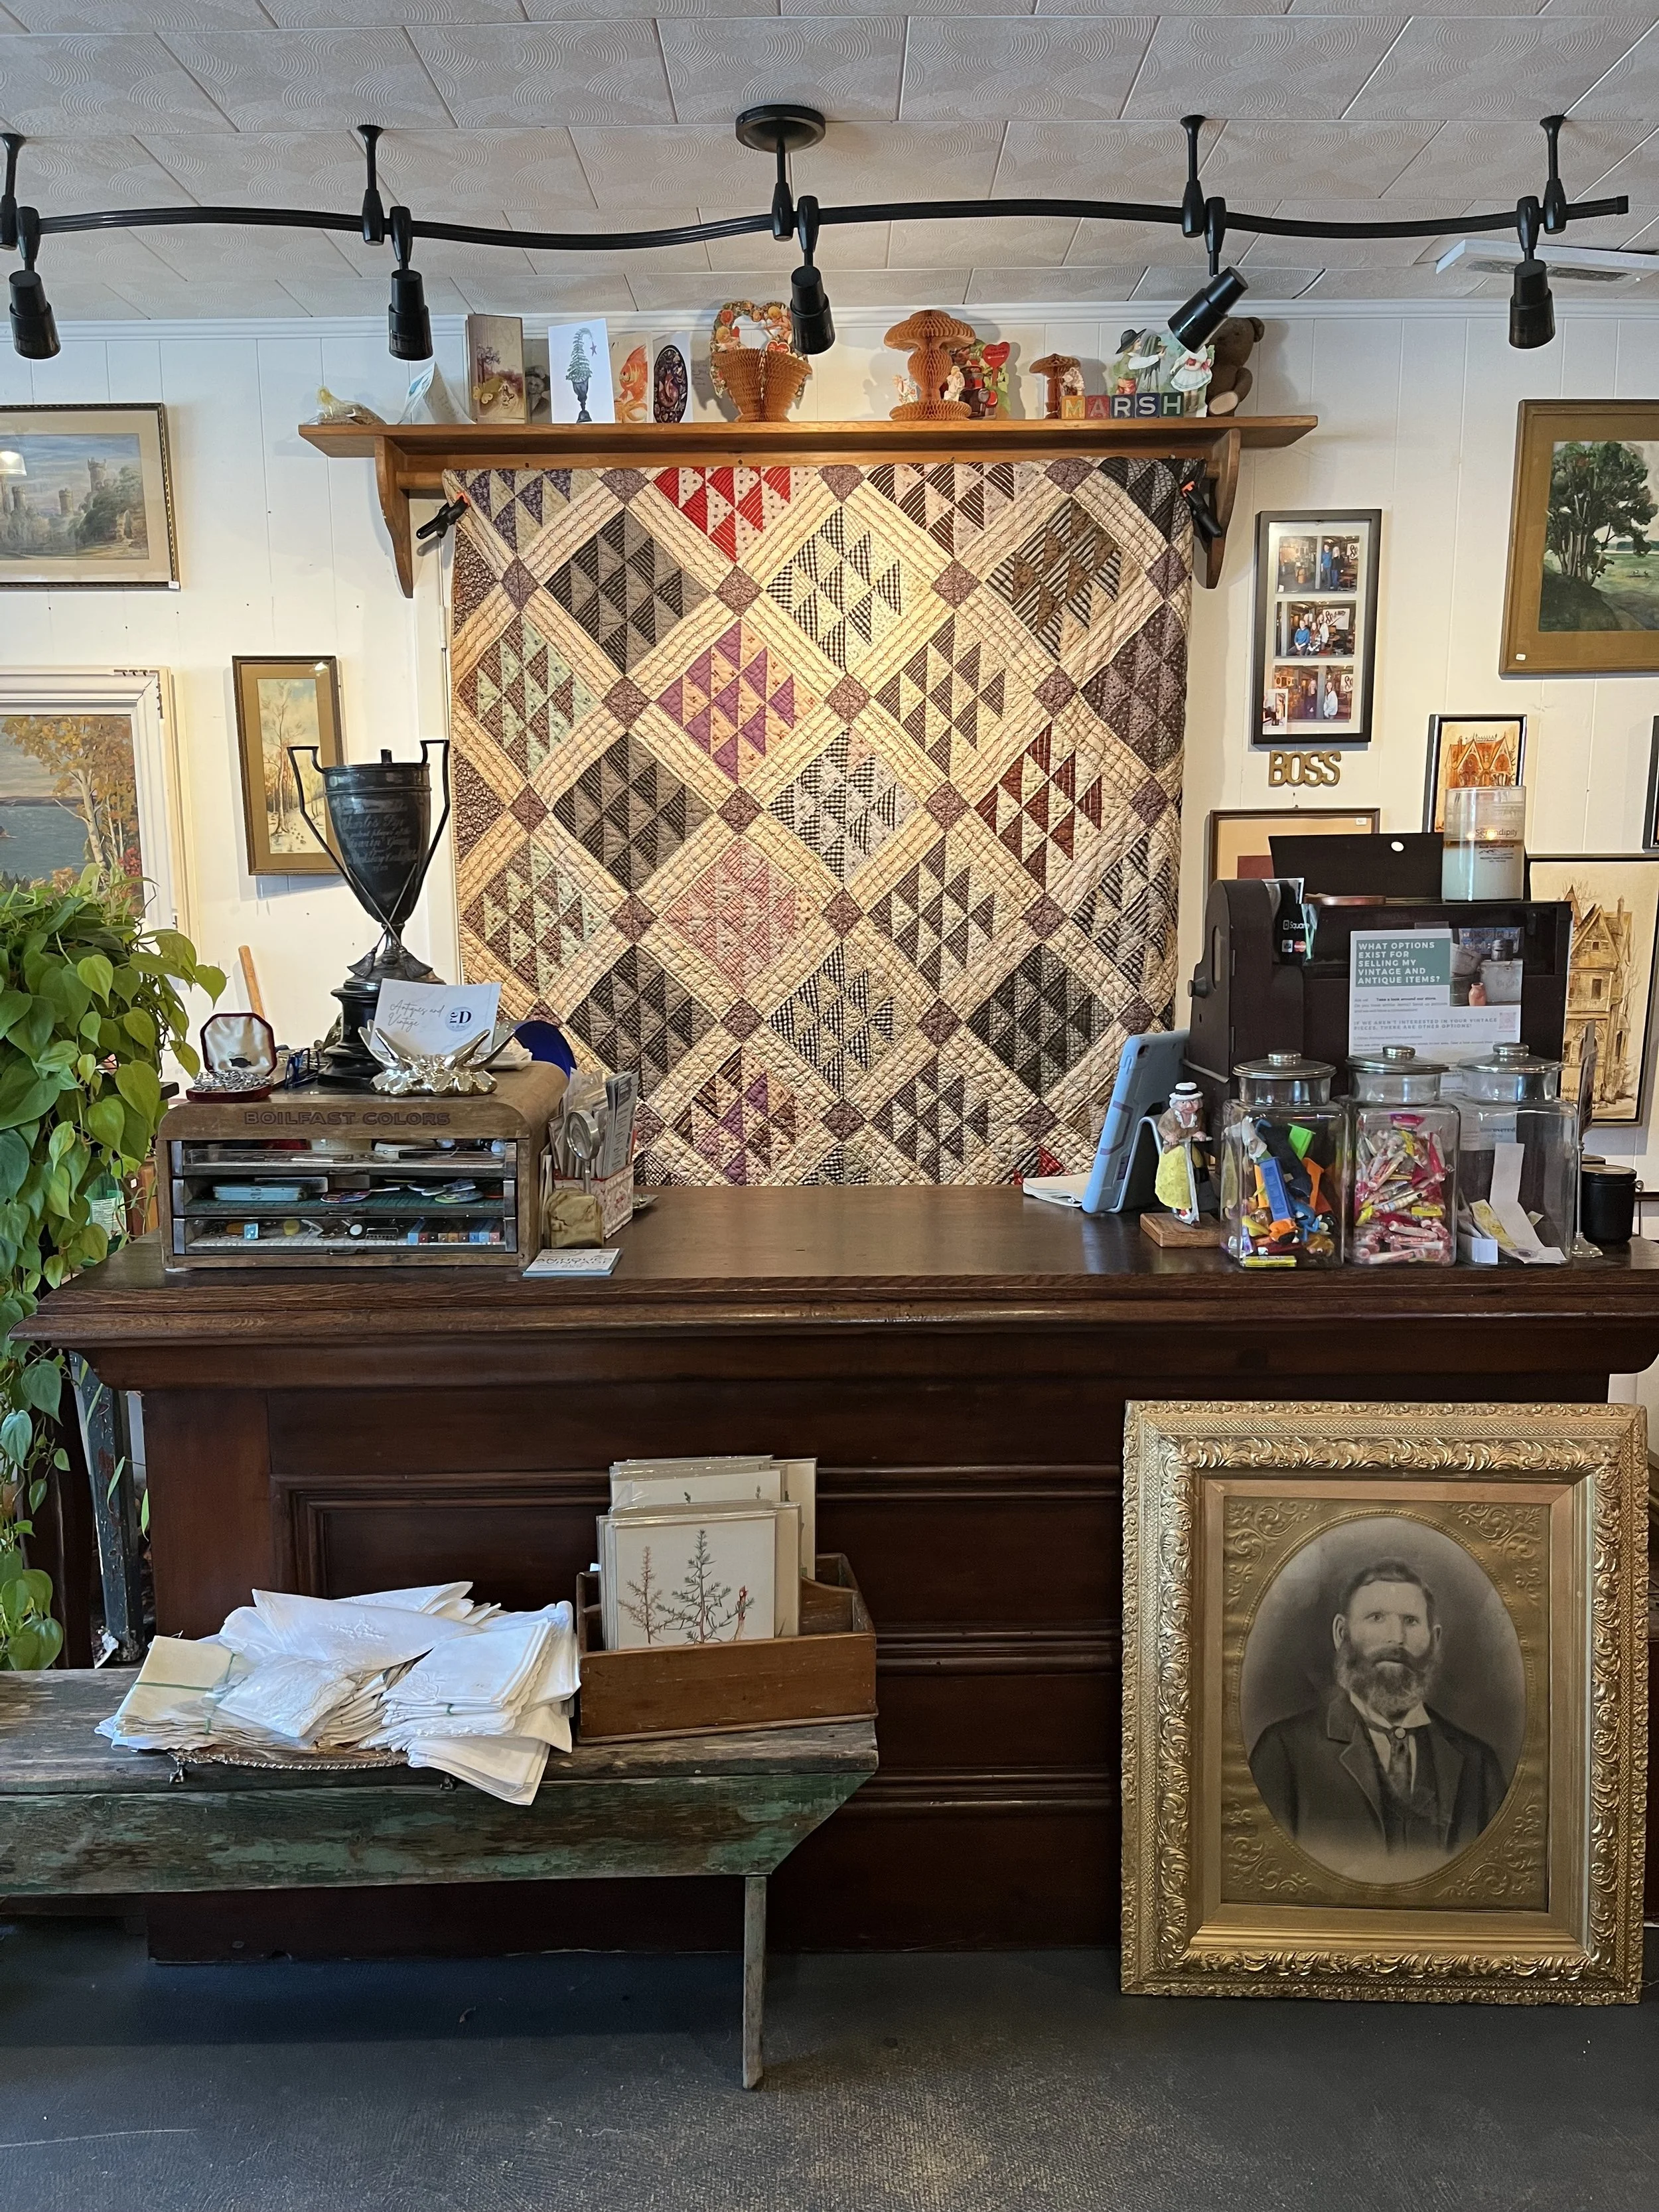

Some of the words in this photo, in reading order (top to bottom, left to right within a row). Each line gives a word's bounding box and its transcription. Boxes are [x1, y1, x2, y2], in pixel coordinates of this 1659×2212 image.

[1065, 396, 1181, 418] MARSH
[1268, 750, 1342, 787] BOSS
[1475, 829, 1518, 838] Sendipity
[1289, 921, 1310, 930] Square
[390, 999, 427, 1016] Antiques
[429, 1005, 445, 1017] and
[388, 1012, 419, 1033] Vintage
[244, 1111, 357, 1126] BOILFAST
[362, 1112, 451, 1126] COLORS
